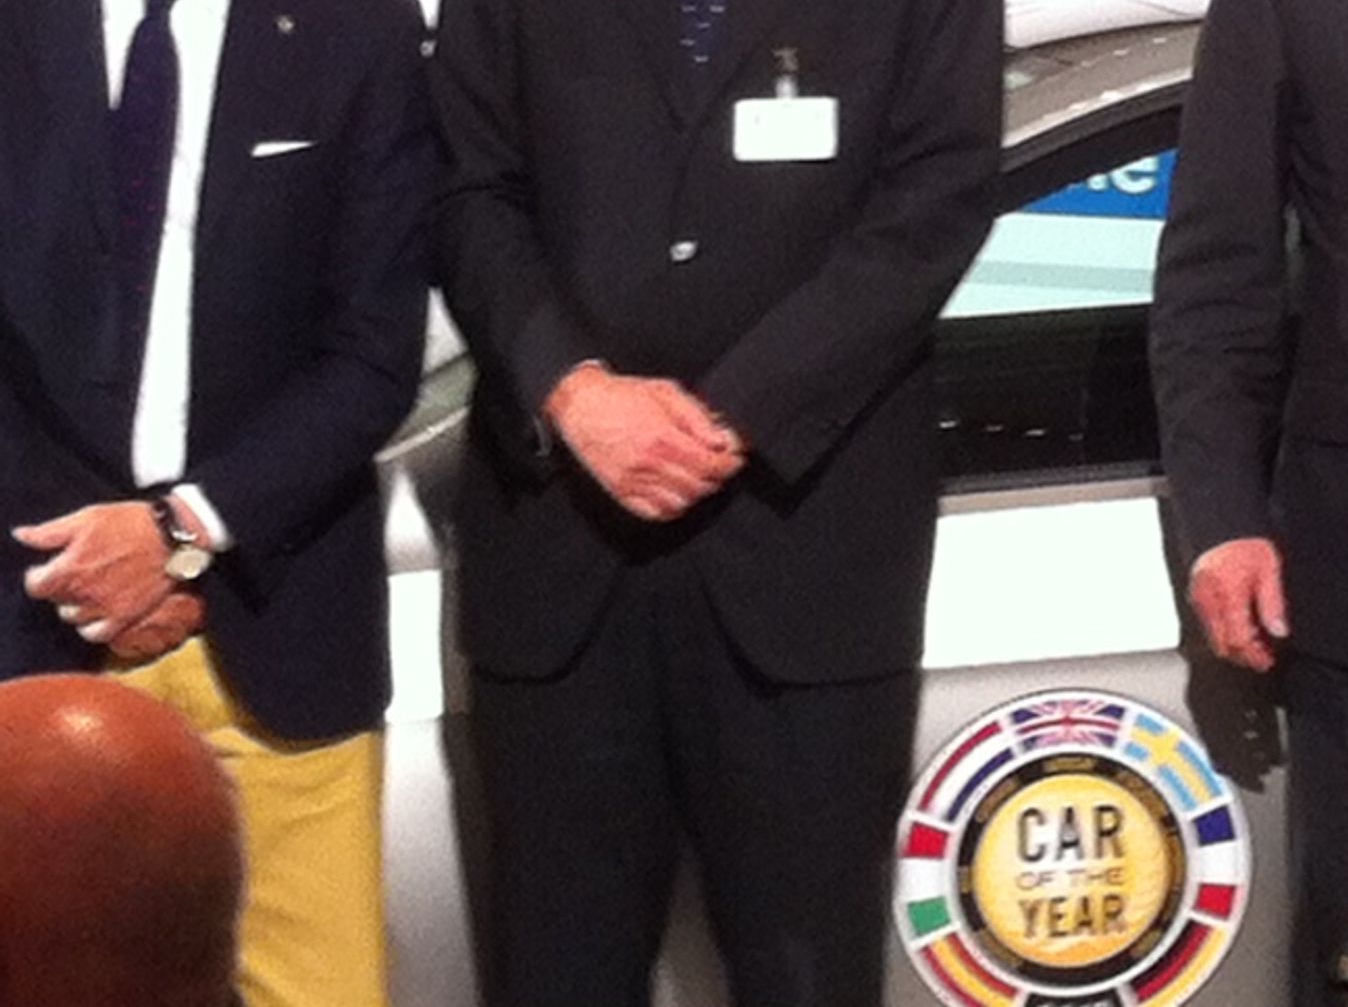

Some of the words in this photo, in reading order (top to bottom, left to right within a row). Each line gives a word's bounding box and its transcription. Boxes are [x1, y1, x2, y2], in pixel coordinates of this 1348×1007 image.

[1018, 804, 1125, 863] CAR
[1015, 871, 1054, 892] OF
[1065, 866, 1125, 886] THE
[1017, 894, 1128, 939] YEAR
